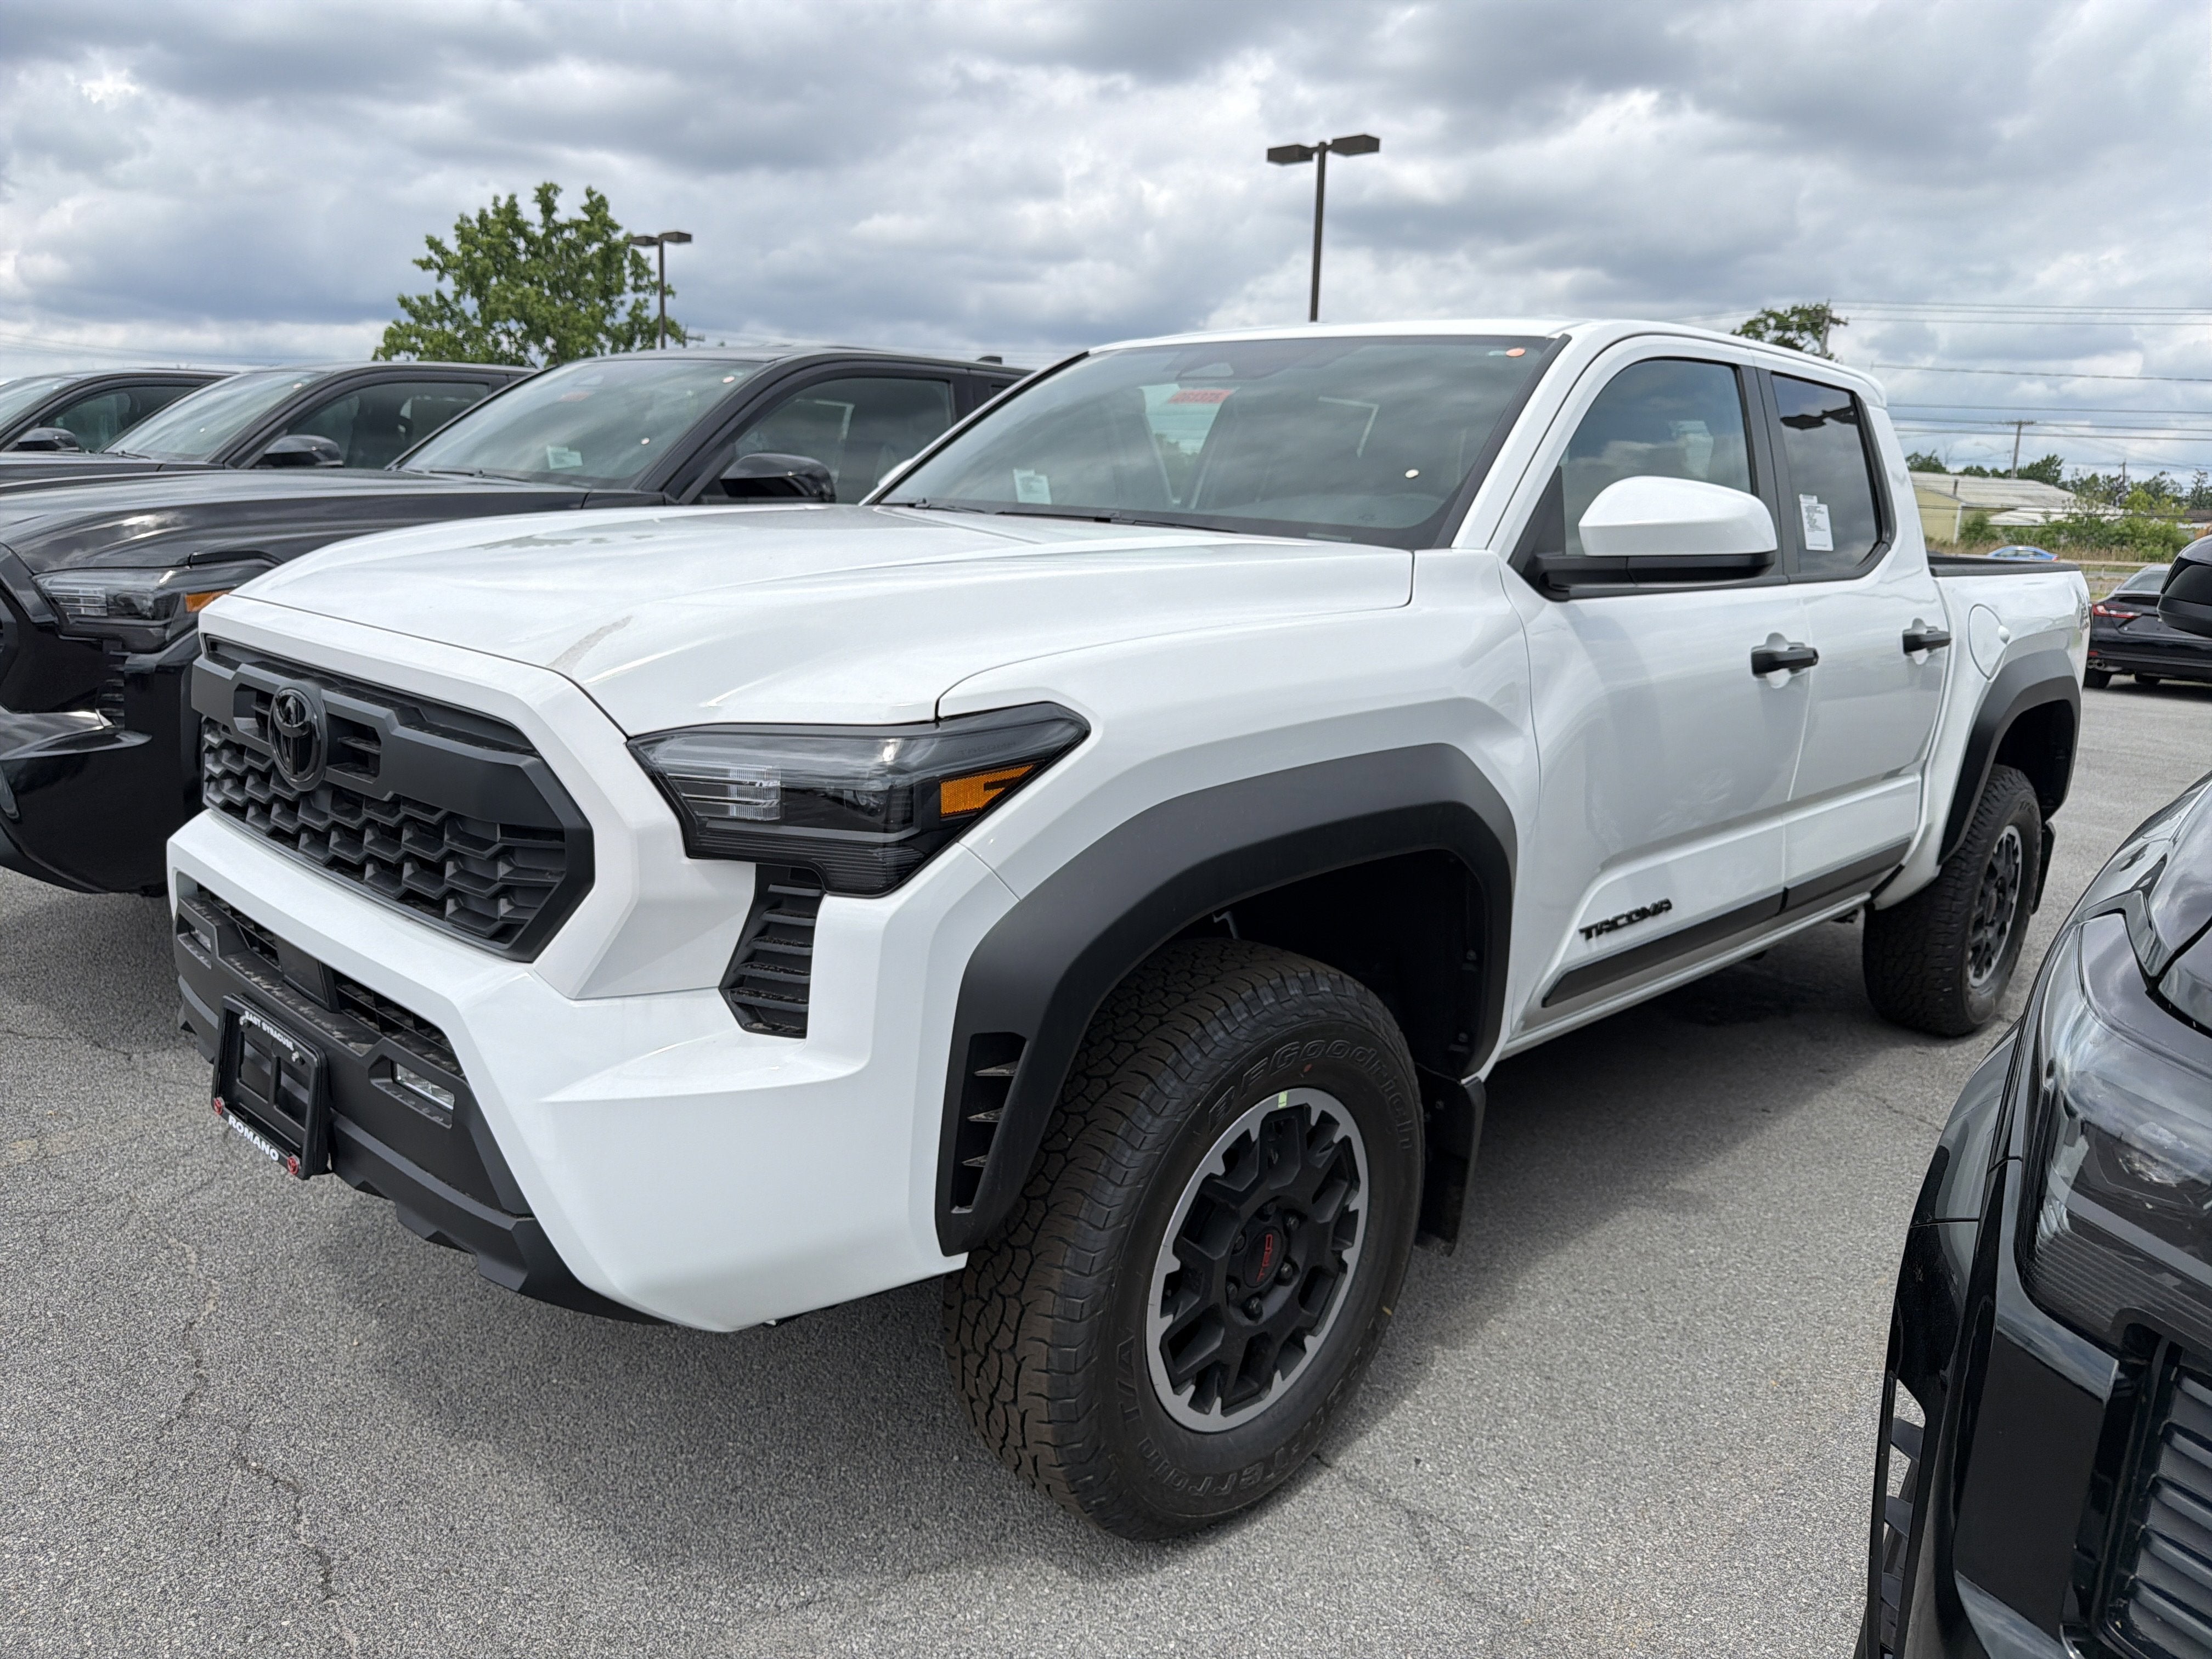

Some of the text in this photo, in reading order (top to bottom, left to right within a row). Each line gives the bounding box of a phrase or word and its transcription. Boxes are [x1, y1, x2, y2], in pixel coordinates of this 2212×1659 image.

[1578, 898, 1672, 940] TACOMA
[228, 1115, 279, 1161] ROMANO
[1256, 1234, 1273, 1282] TRD
